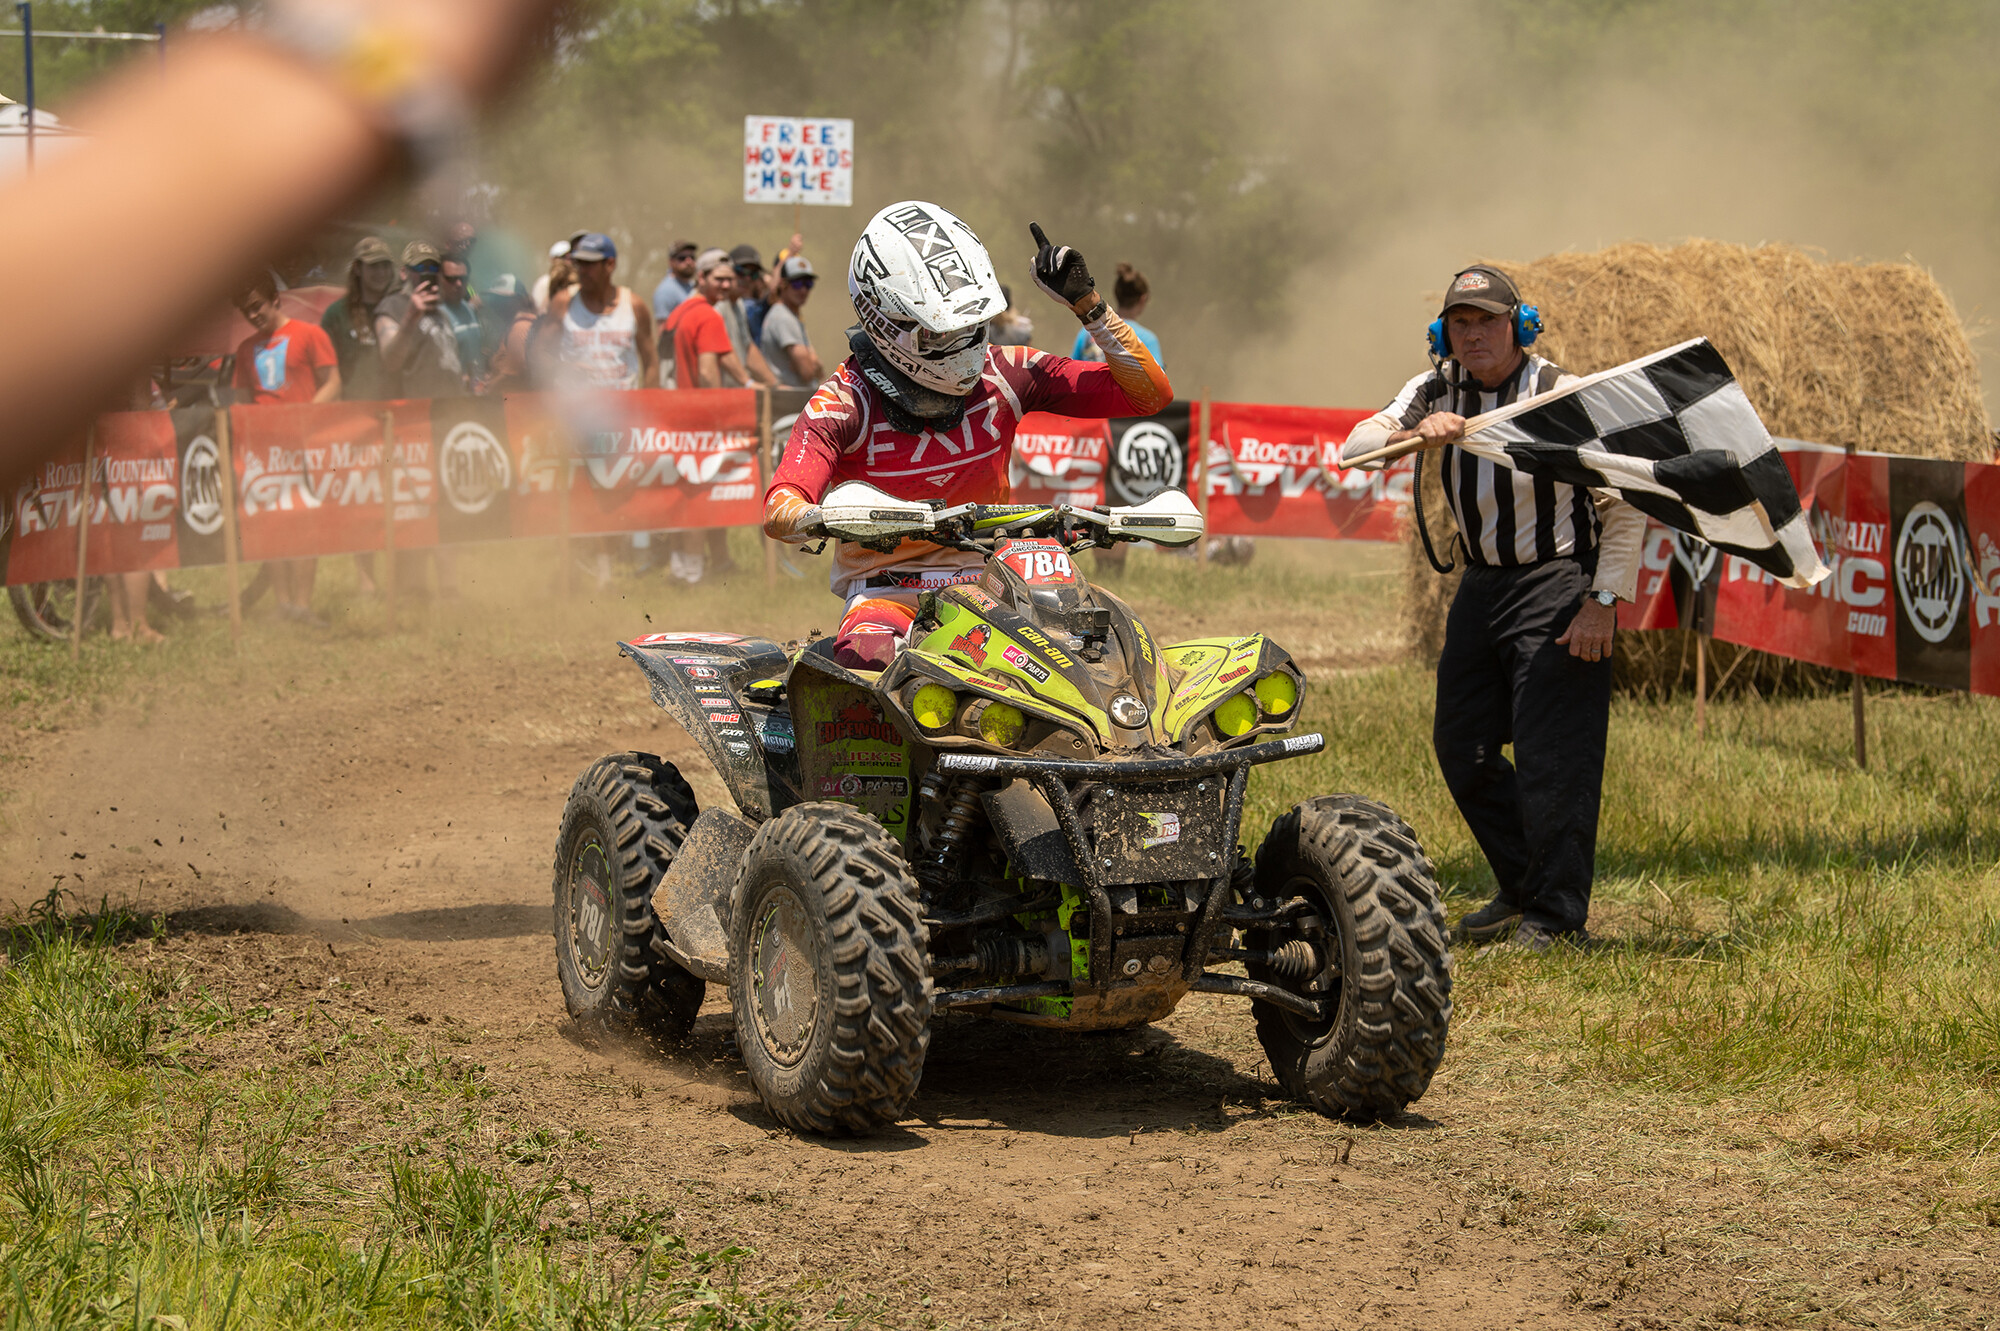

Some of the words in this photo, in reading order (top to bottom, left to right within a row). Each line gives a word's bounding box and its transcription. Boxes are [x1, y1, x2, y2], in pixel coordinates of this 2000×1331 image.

[762, 123, 834, 145] FREE
[746, 147, 852, 168] HOWARDS
[762, 170, 833, 191] HOLE
[264, 357, 276, 386] 1
[630, 427, 752, 452] MOUNTAIN
[866, 396, 1001, 466] FXR
[268, 447, 328, 473] ROCKY
[1239, 438, 1316, 465] ROCKY
[44, 461, 83, 489] ROCKY
[1018, 551, 1072, 580] 784
[948, 634, 988, 668] EDGEWOOD
[1017, 626, 1074, 669] can-am
[1131, 619, 1153, 664] can-am
[1005, 649, 1018, 659] JAY
[1025, 662, 1047, 681] PARTS
[1218, 665, 1250, 684] Nine2
[710, 713, 740, 723] Nine2
[720, 728, 744, 737] FXR
[859, 760, 902, 768] SERVICE
[1163, 822, 1181, 836] 784
